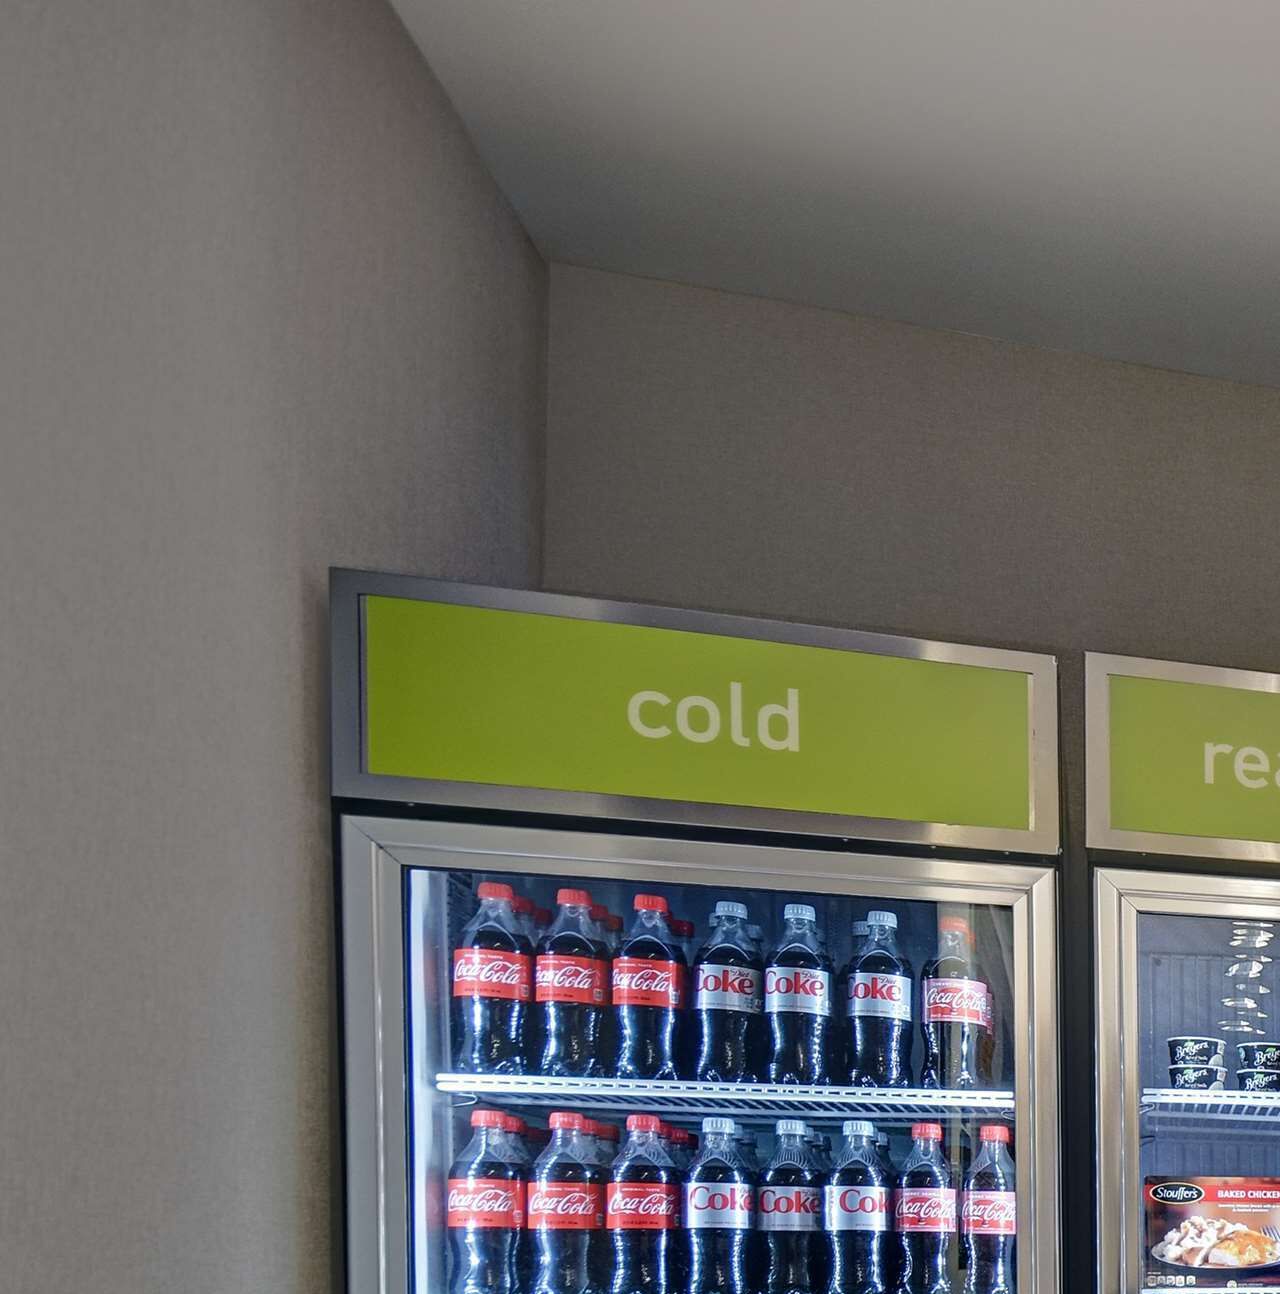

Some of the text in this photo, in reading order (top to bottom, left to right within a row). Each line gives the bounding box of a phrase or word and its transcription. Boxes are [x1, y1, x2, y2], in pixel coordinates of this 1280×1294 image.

[627, 680, 800, 752] cold
[454, 958, 522, 985] Coca-Cola
[764, 970, 825, 997] Coke
[1174, 1041, 1209, 1061] Breyers
[448, 1188, 515, 1212] Coca-Cola
[529, 1191, 598, 1215] Coca-Cola
[608, 1191, 674, 1215] Coca-Cola
[839, 1189, 888, 1214] Cok
[1156, 1186, 1198, 1200] Stouffer's
[1217, 1190, 1246, 1199] BAKED
